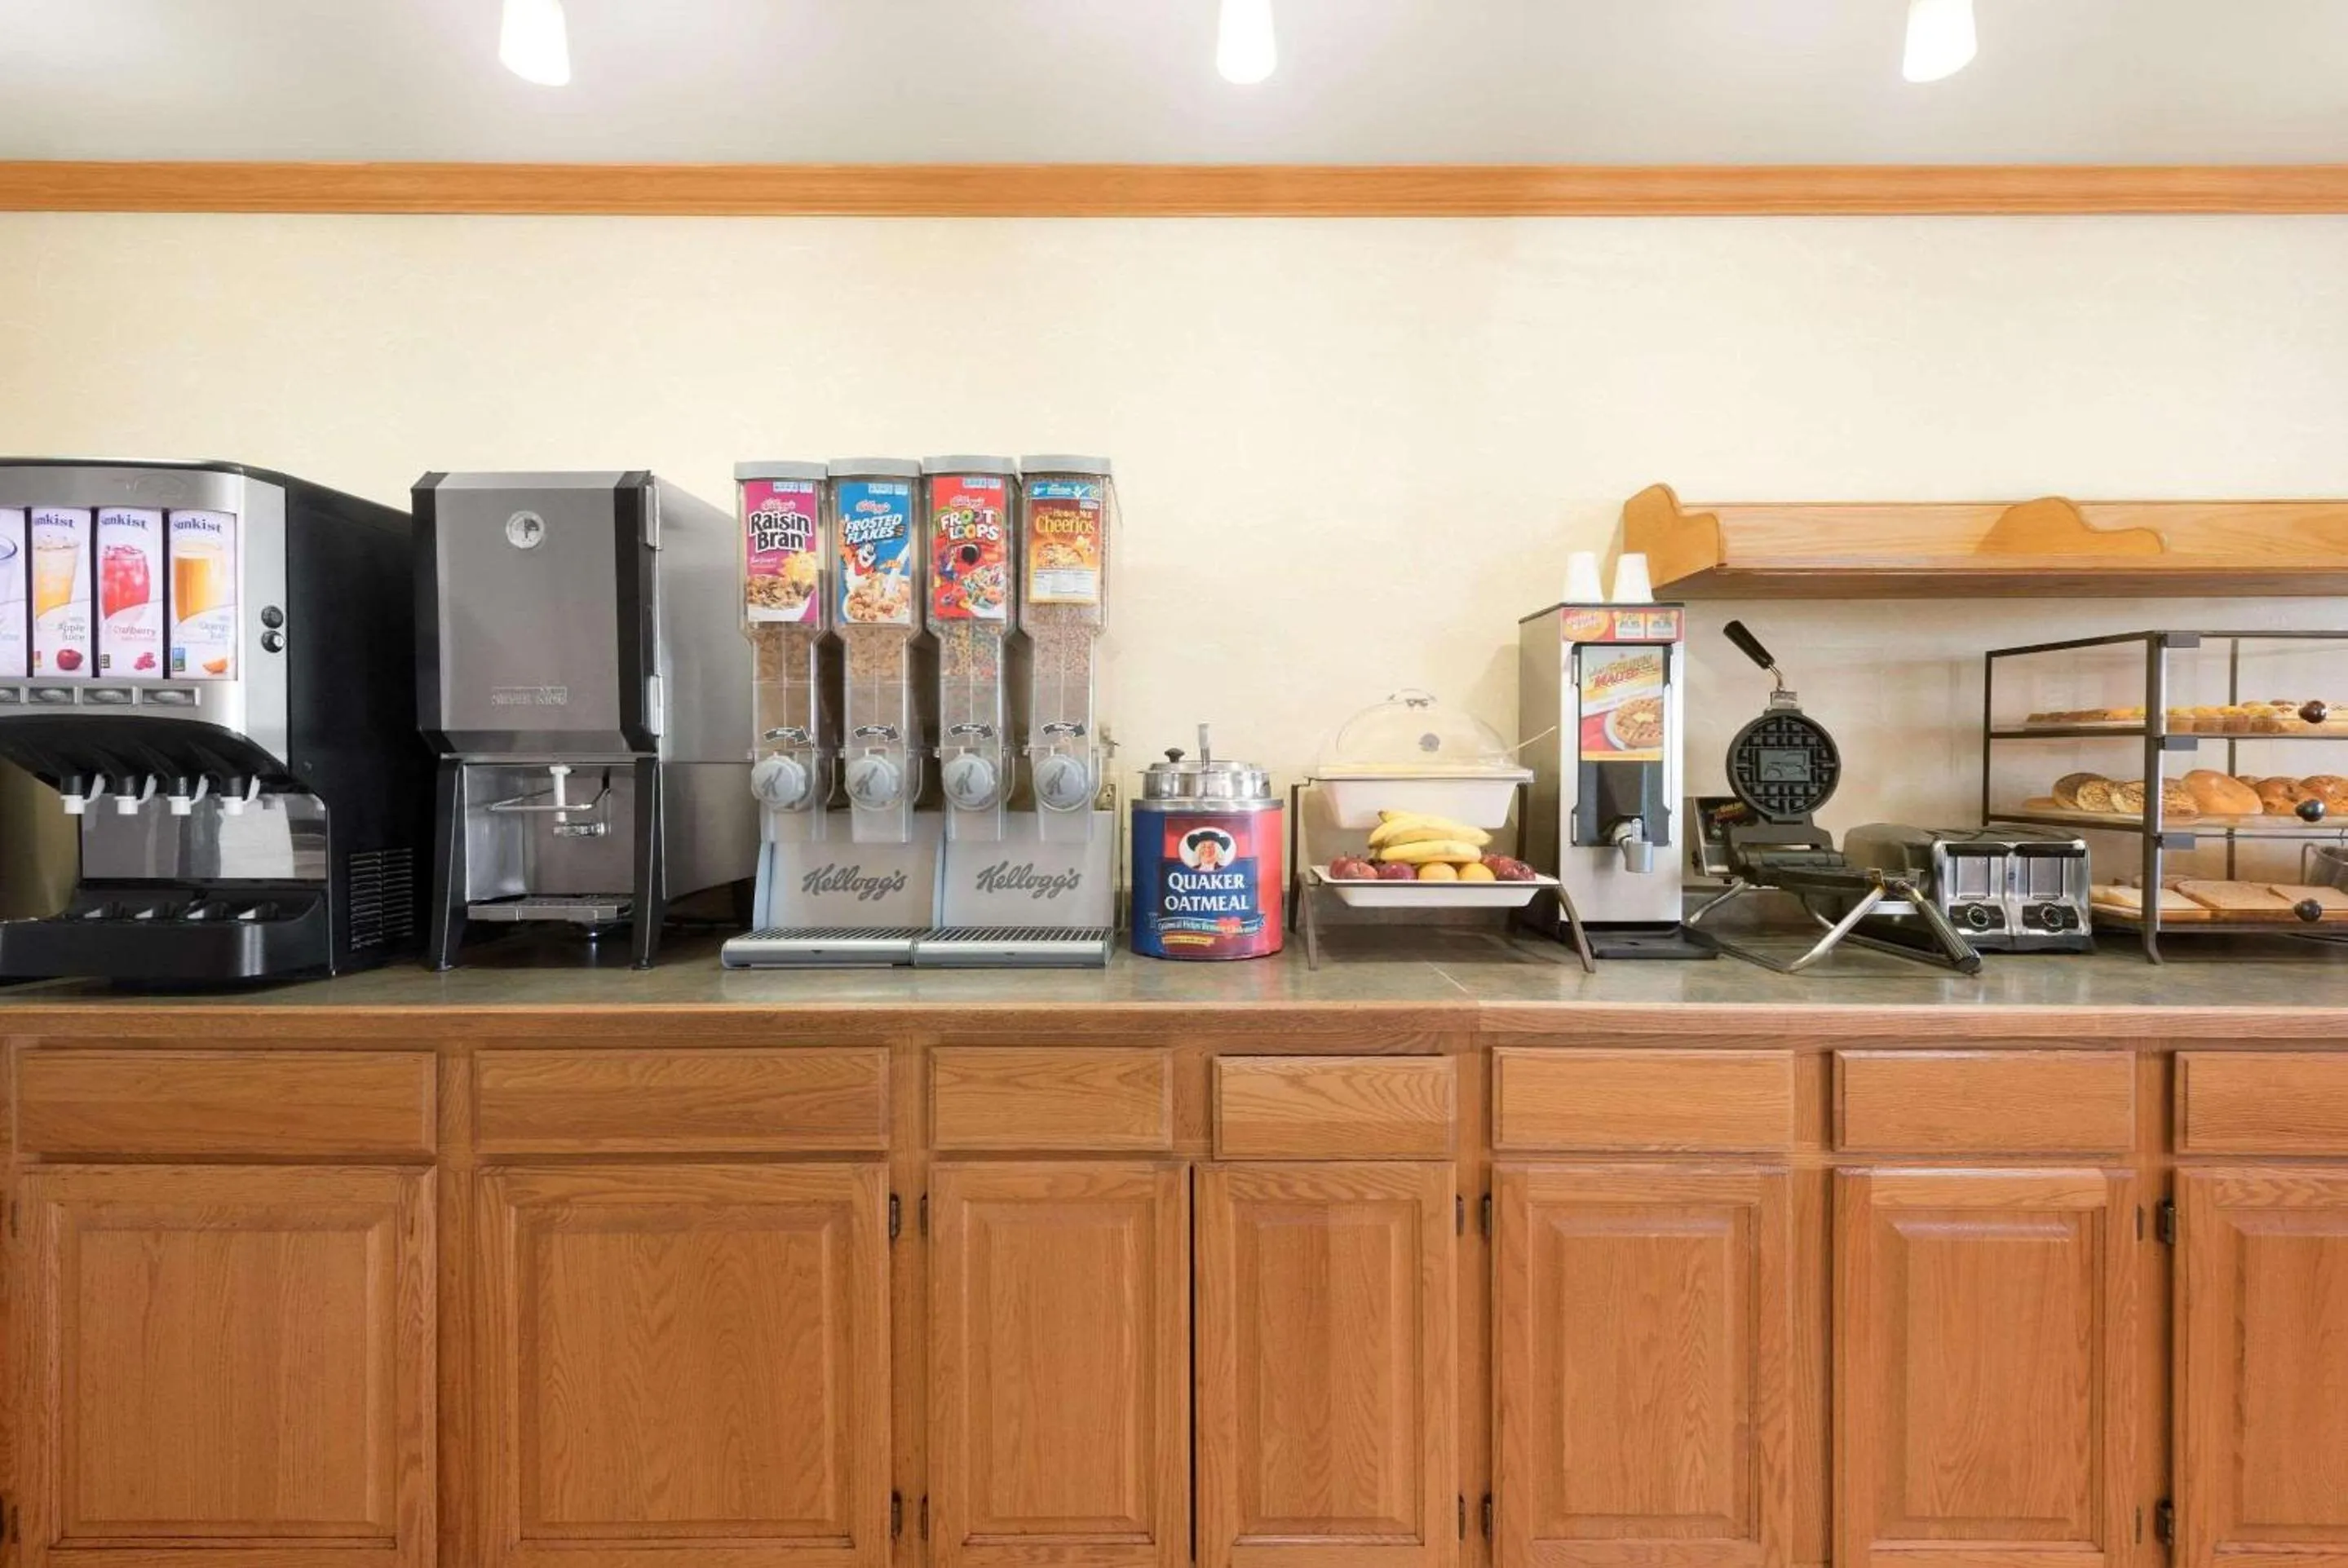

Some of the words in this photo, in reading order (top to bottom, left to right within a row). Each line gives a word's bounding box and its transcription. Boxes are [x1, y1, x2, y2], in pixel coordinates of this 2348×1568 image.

[750, 512, 810, 535] Raisin
[845, 514, 902, 535] FROSTED
[940, 508, 994, 531] FROOT
[1036, 515, 1096, 536] Cheerios
[757, 532, 804, 551] Bran
[846, 526, 895, 545] FLAKES
[949, 523, 1000, 541] LOOPS
[802, 863, 909, 901] Kellogg's
[975, 860, 1082, 899] Kellogg's
[1168, 872, 1245, 892] QUAKER
[1164, 895, 1249, 911] OATMEAL
